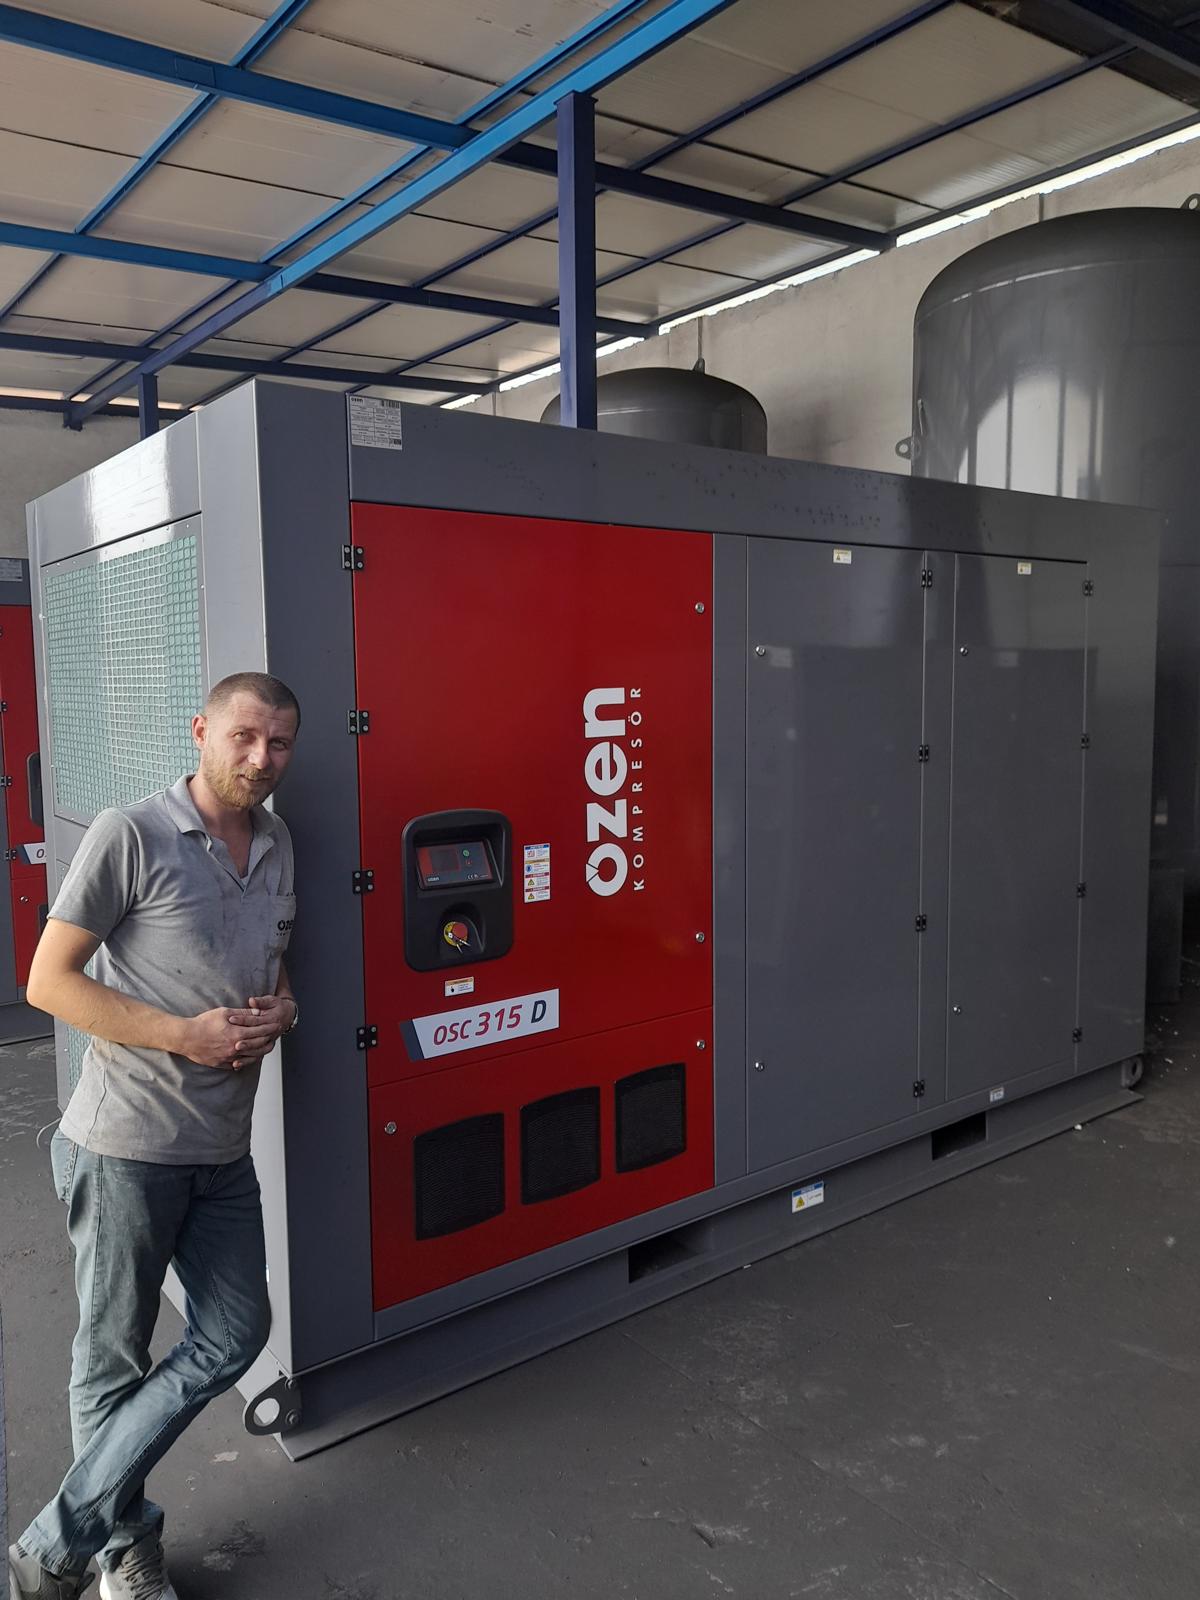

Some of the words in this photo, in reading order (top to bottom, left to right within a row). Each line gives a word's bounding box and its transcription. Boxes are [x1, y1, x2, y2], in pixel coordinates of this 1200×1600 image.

[583, 687, 628, 897] ozen
[628, 688, 644, 891] KOMPRESÖR
[433, 1020, 472, 1045] OSC
[475, 1004, 522, 1036] 315
[531, 999, 547, 1023] D
